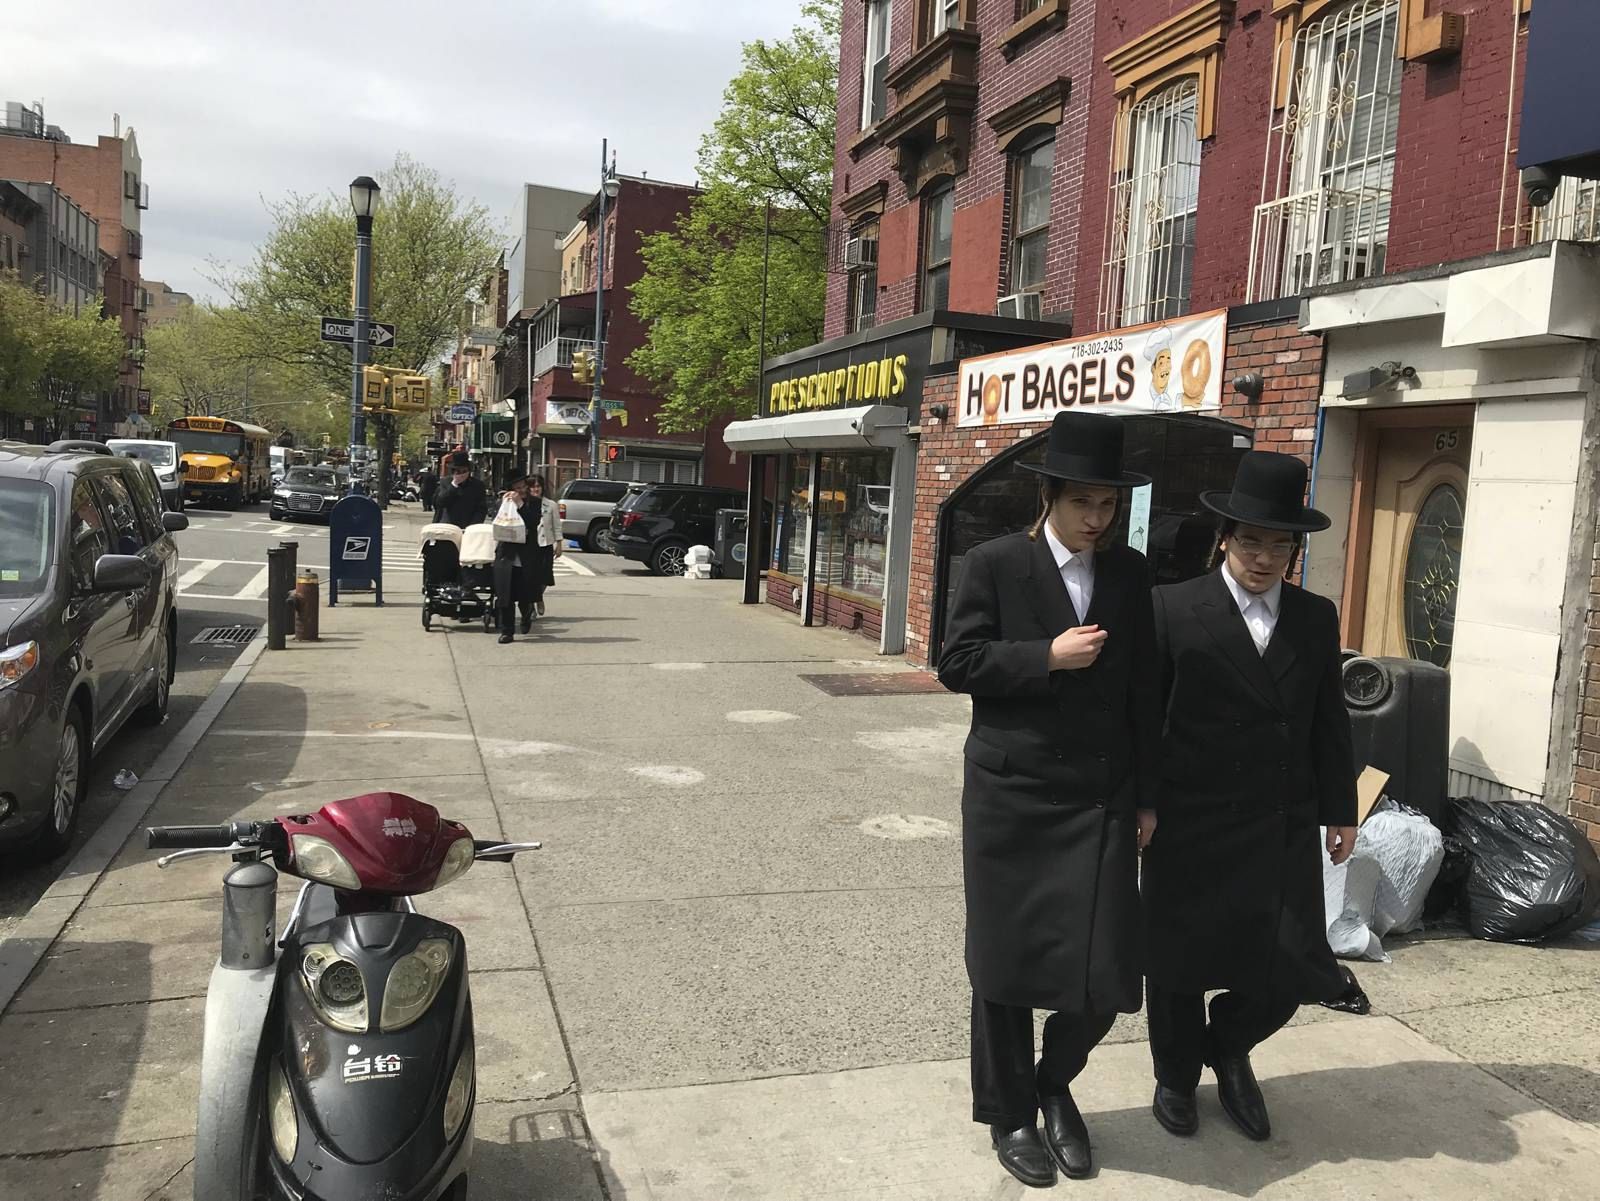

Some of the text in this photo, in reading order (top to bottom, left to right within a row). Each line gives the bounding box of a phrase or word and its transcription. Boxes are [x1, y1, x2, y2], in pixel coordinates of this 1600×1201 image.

[327, 324, 351, 336] ONE
[1070, 337, 1124, 359] 718-302-2435
[770, 354, 907, 415] PRESCRIPTIONS
[966, 354, 1136, 417] HOT BAGELS
[1436, 430, 1457, 451] 65
